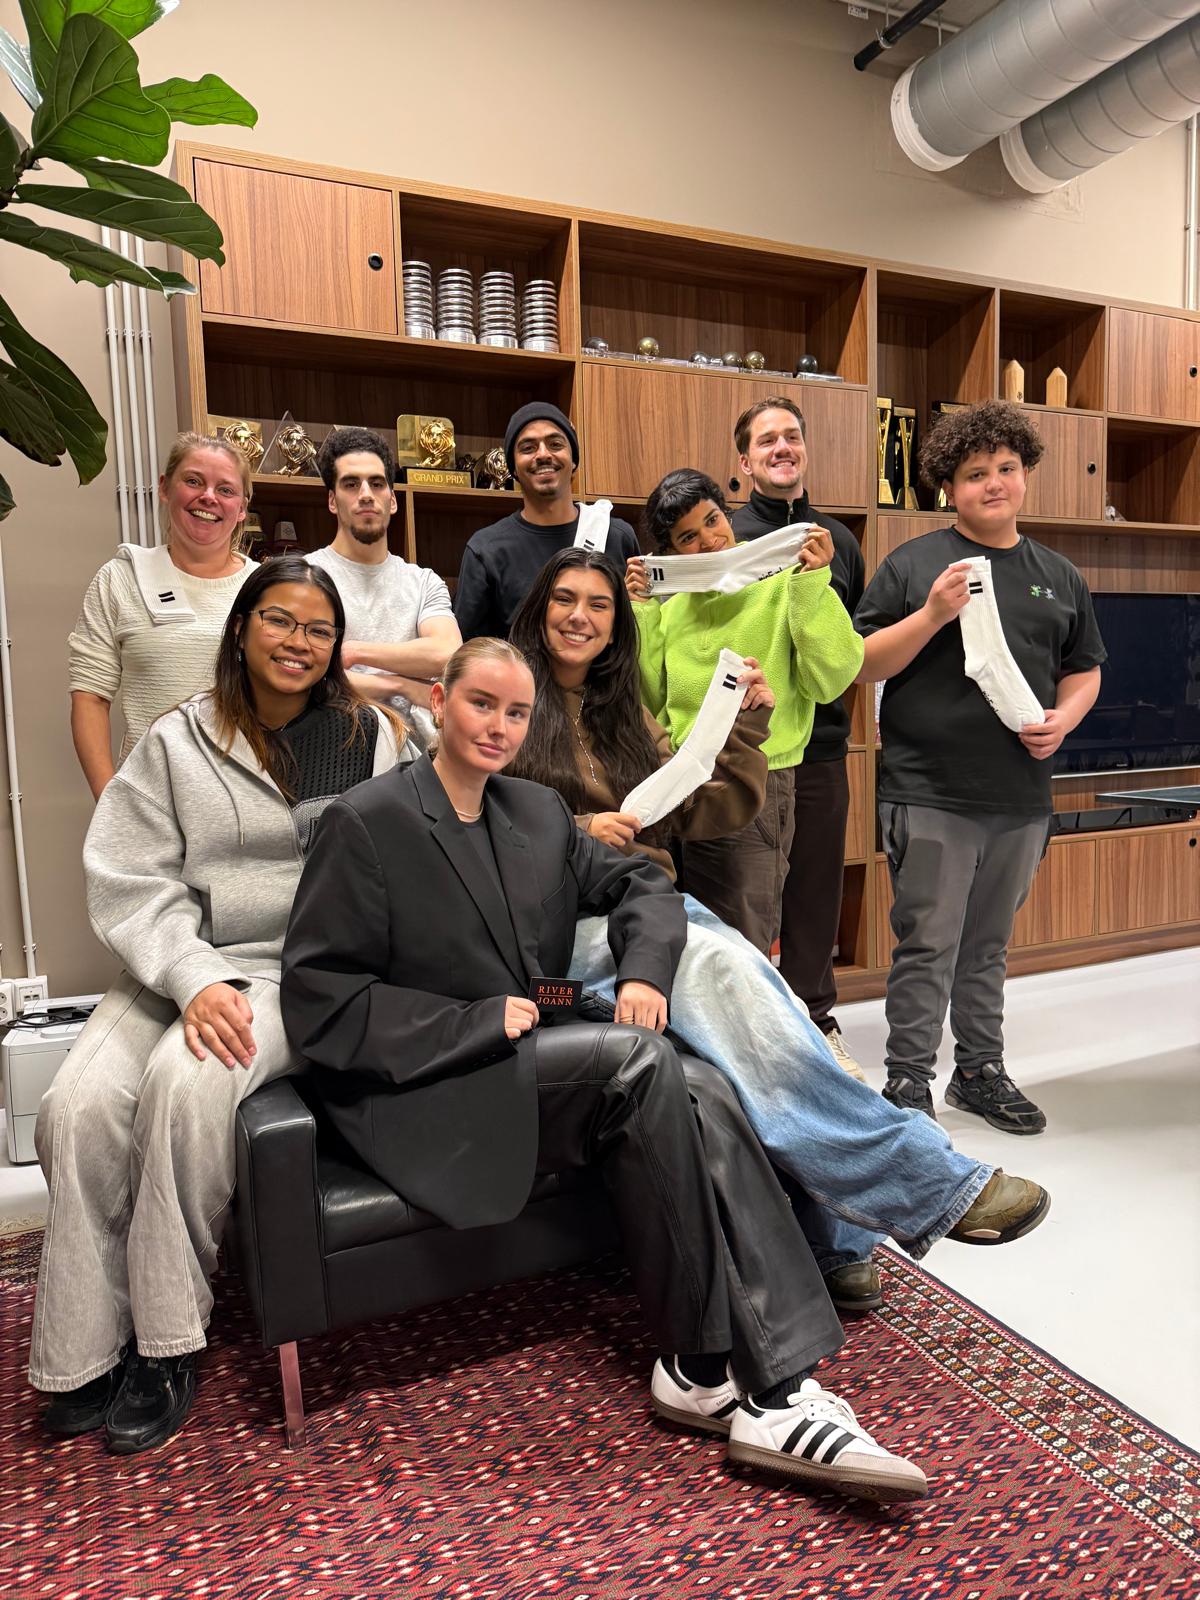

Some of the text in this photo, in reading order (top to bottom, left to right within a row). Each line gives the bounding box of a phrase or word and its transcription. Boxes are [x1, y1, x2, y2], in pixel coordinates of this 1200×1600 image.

[414, 473, 465, 484] GRAND PRIX
[538, 985, 573, 995] RIVER
[536, 996, 573, 1006] JOANN
